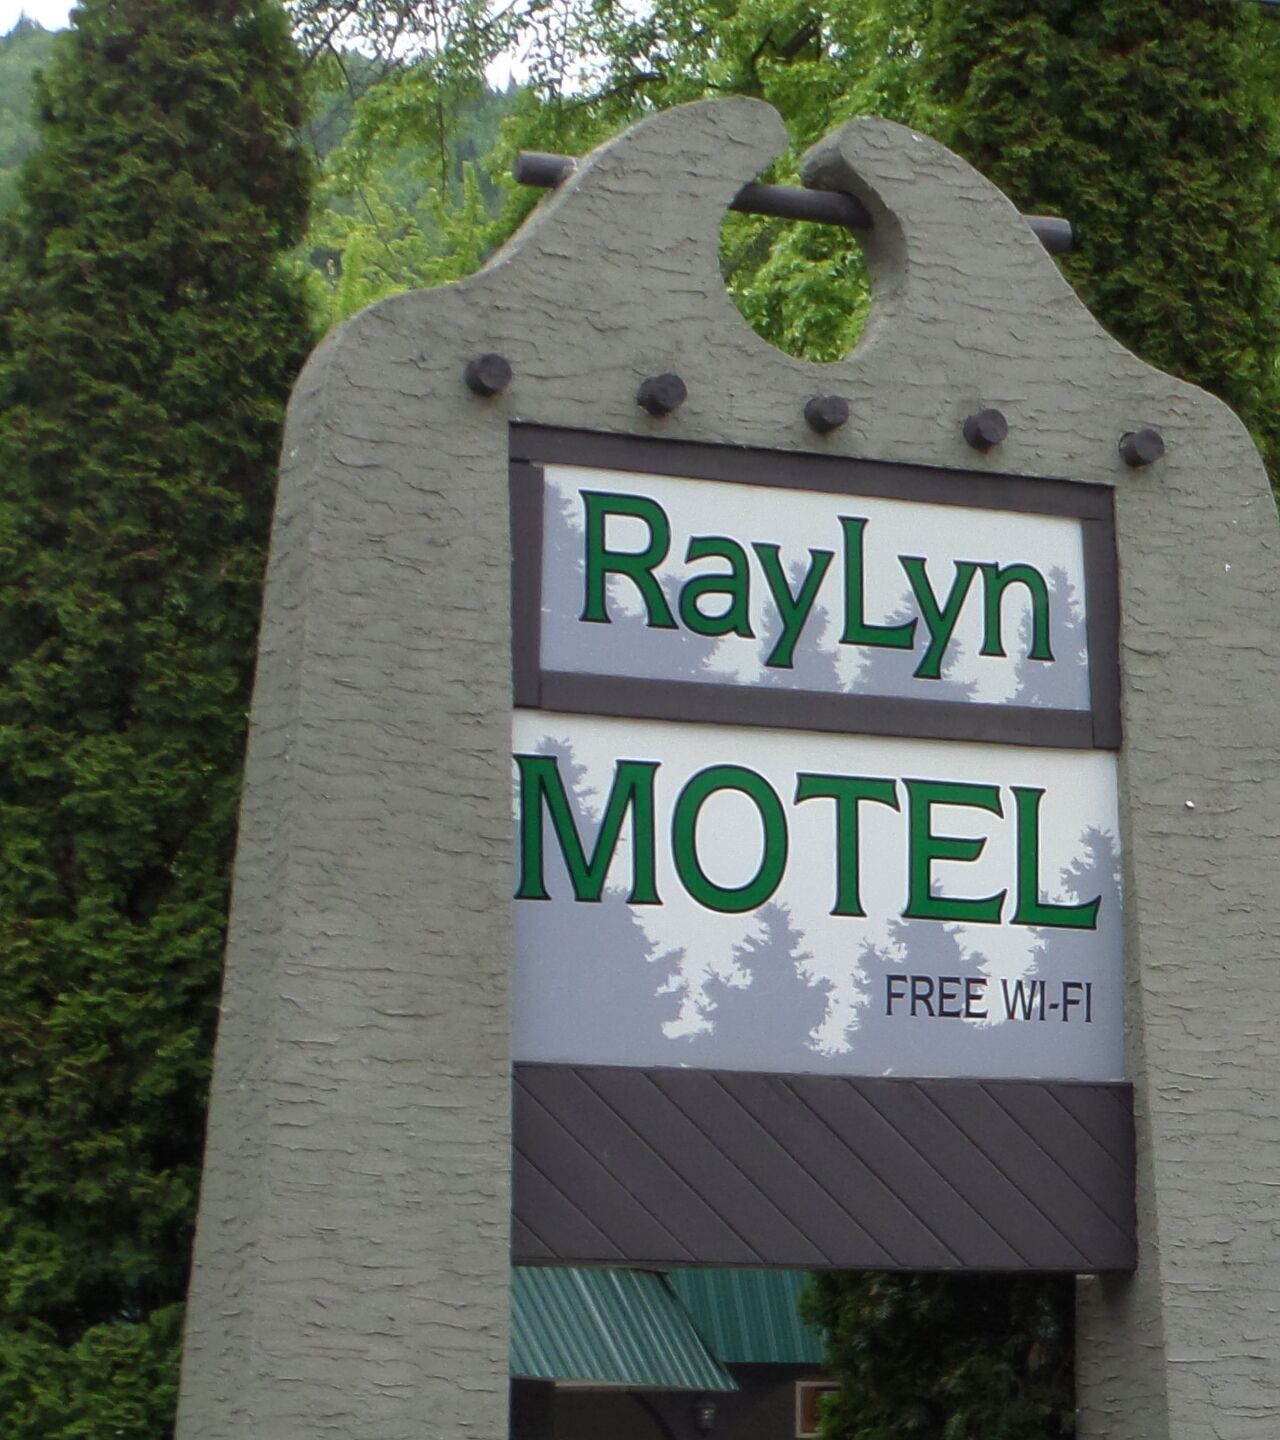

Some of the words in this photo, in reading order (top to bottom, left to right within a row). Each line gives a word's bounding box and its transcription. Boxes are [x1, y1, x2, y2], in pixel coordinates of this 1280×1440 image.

[579, 489, 1056, 680] RayLyn
[513, 753, 1103, 930] MOTEL
[885, 974, 989, 1019] FREE
[1000, 978, 1093, 1023] WI-FI
